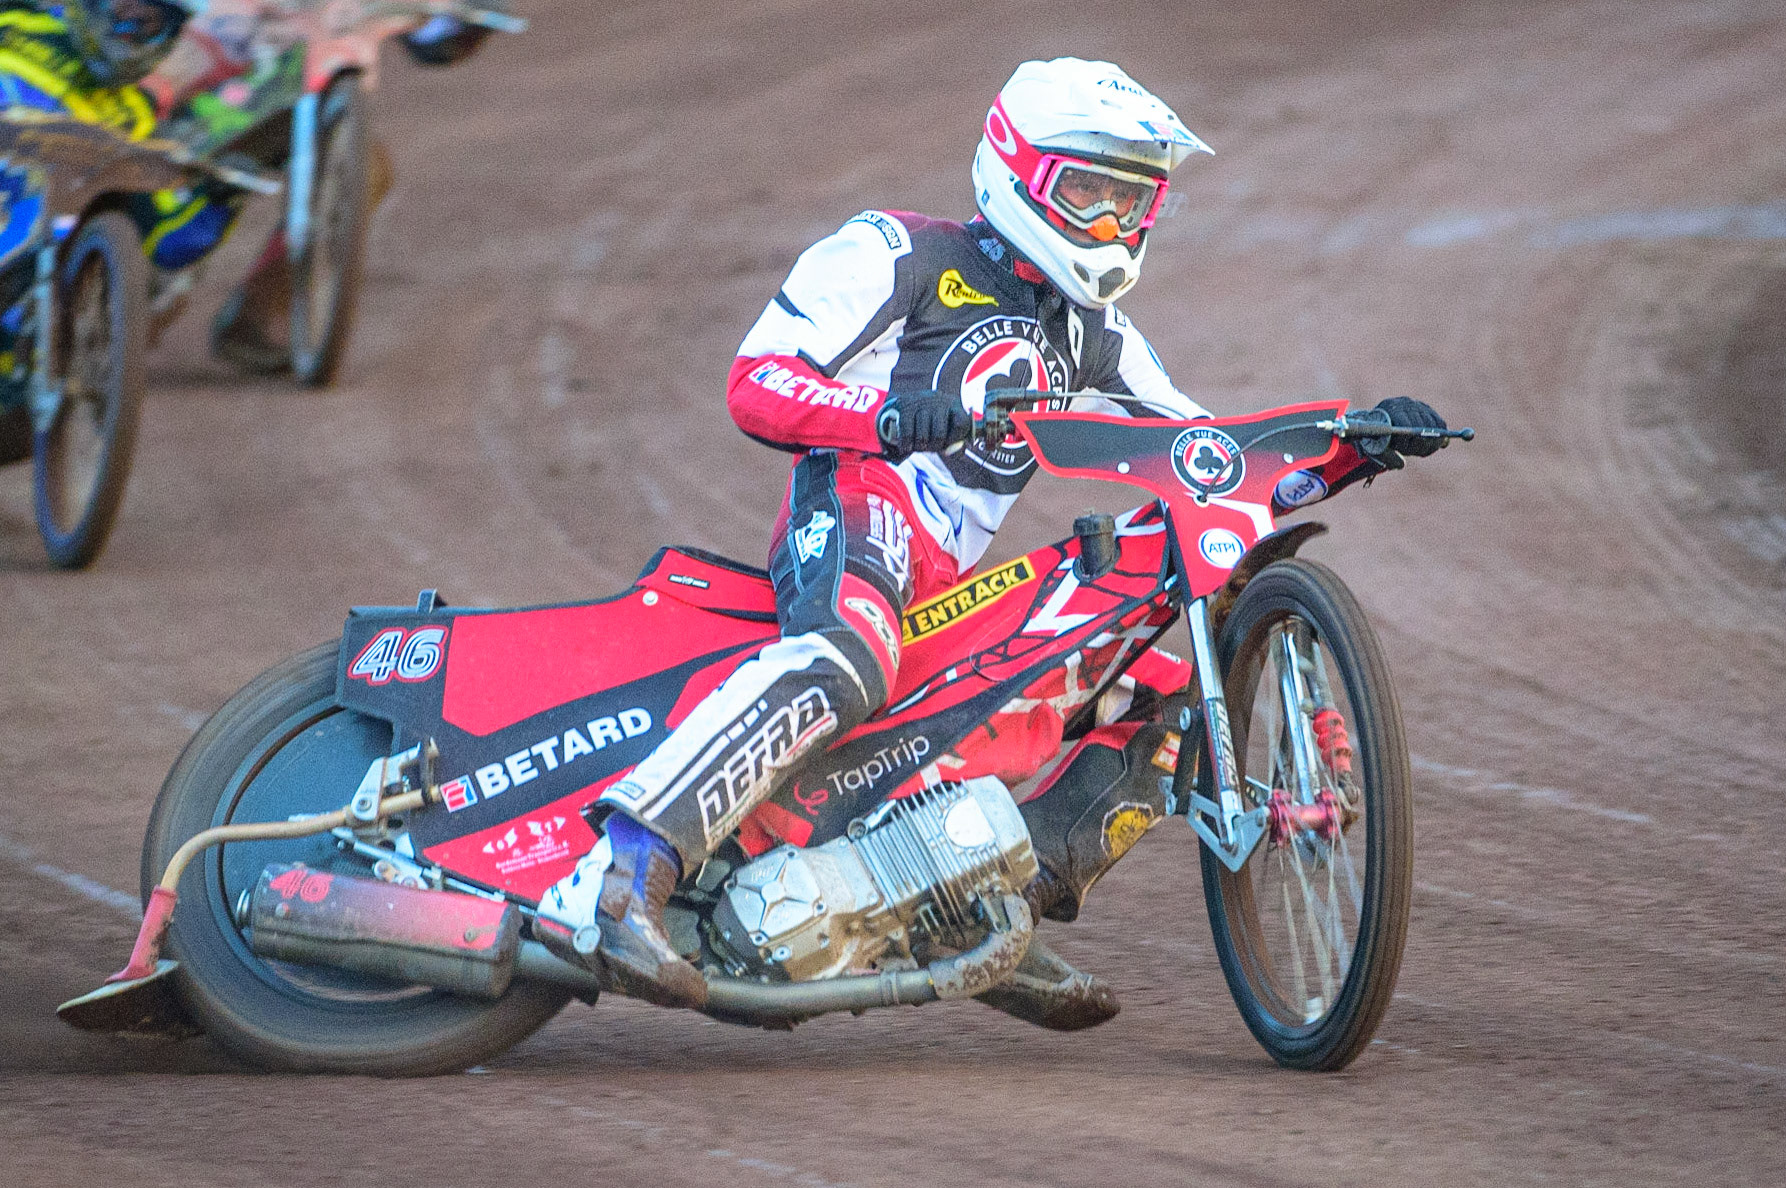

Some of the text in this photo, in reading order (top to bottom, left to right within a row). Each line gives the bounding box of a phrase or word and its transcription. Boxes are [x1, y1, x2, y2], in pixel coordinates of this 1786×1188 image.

[961, 320, 1014, 355] BELLE
[1021, 322, 1050, 355] VUE
[762, 367, 879, 414] BETARD
[1175, 430, 1237, 458] BELLE VUE ACES
[1208, 541, 1236, 554] ATPI
[349, 627, 448, 685] 46
[474, 707, 653, 800] BETARD
[826, 735, 930, 796] TapTrip
